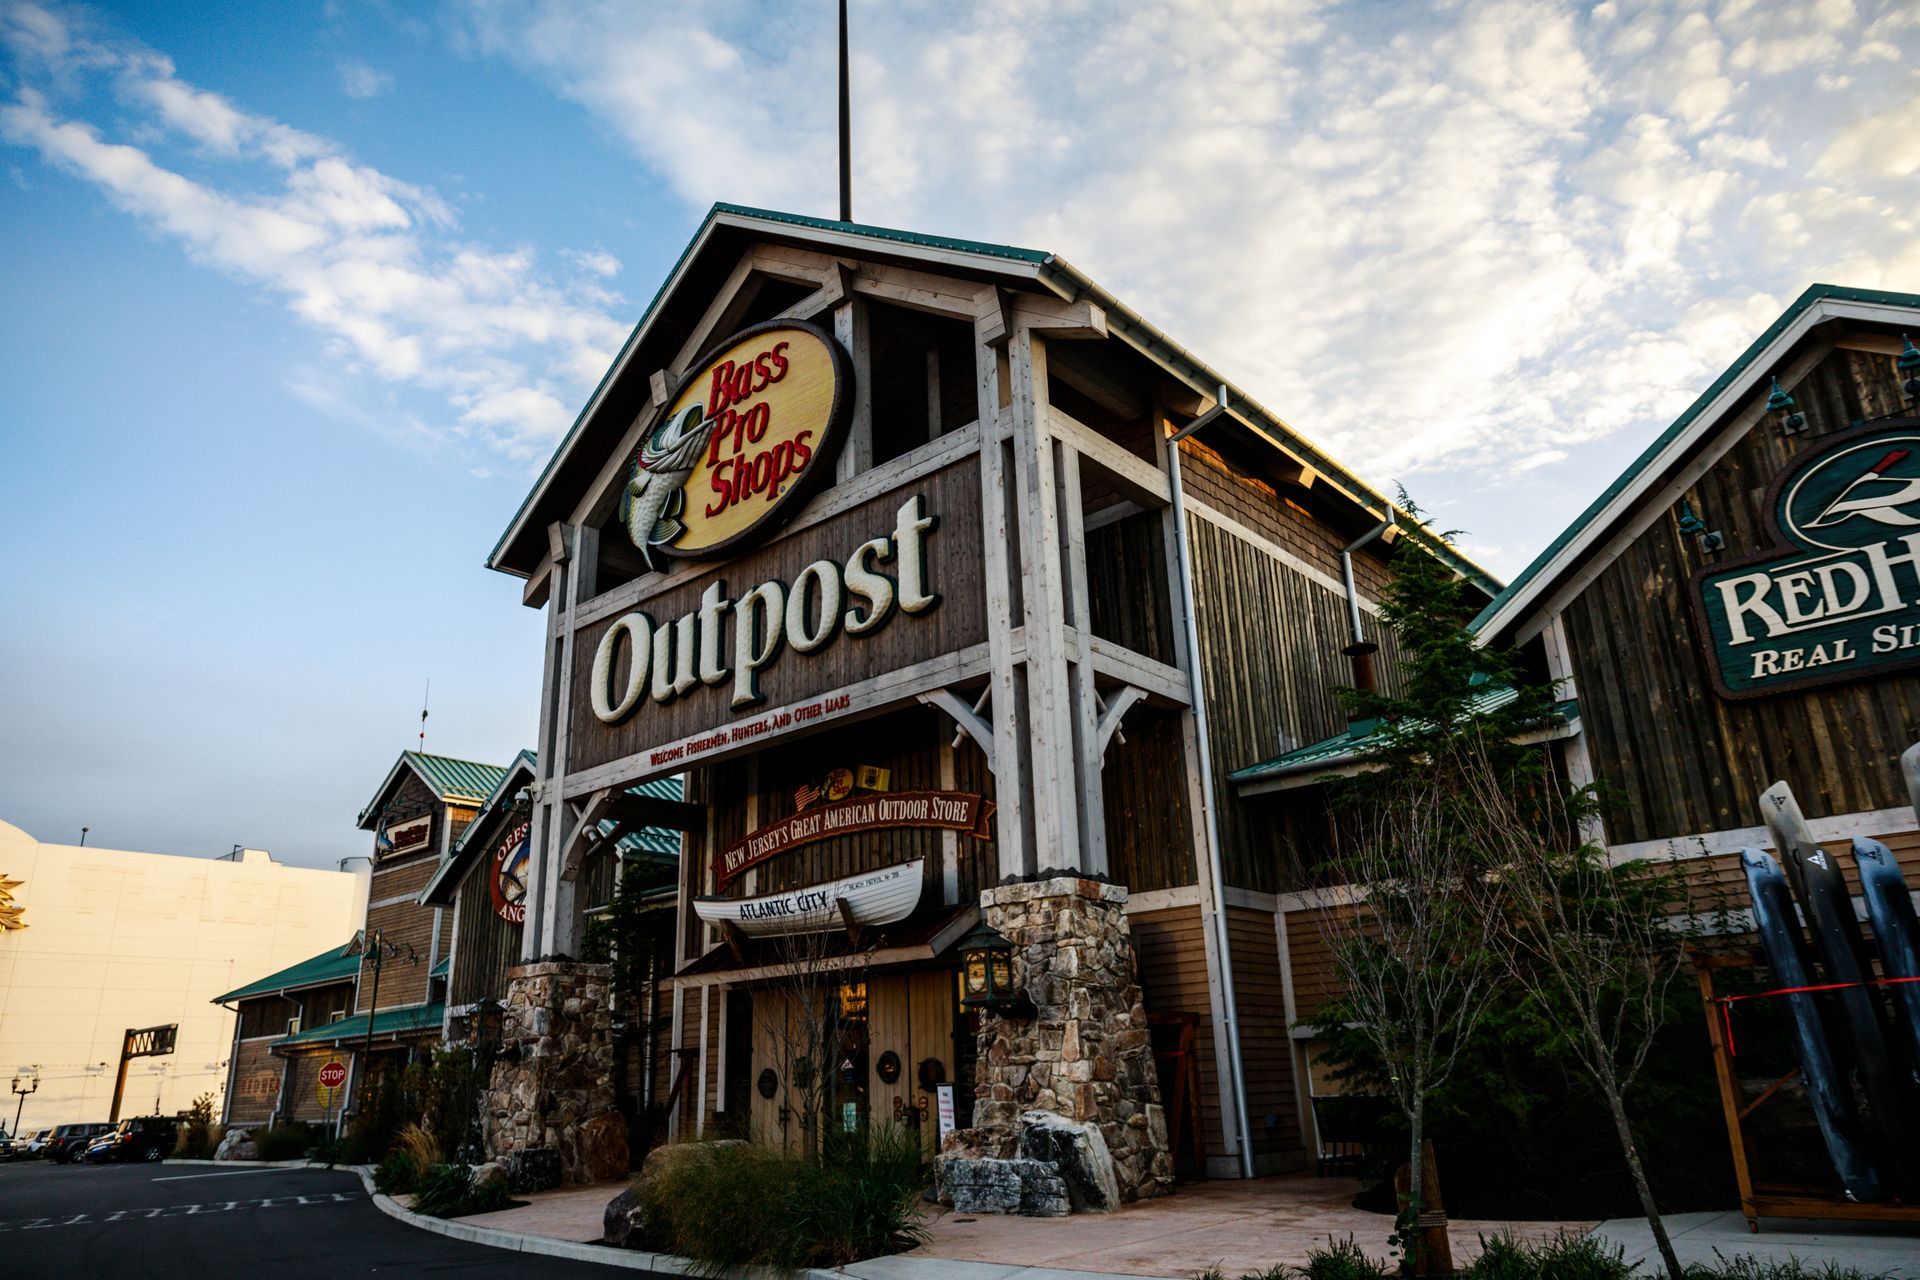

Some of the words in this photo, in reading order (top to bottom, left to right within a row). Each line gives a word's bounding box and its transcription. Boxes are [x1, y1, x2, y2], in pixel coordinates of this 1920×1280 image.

[706, 341, 789, 420] Bass
[706, 402, 770, 469] Pro
[706, 430, 813, 519] Shops
[591, 494, 938, 724] Outpost
[1750, 639, 1856, 679] REAL
[650, 746, 684, 767] WELCOME
[686, 732, 731, 756] FISHERMEN,
[731, 719, 771, 743] HUNTERS,
[772, 713, 792, 730] AND
[794, 703, 822, 723] OTHER
[825, 694, 850, 714] LIARS
[724, 847, 745, 873] NEW
[747, 827, 789, 860] JERSEY'S
[790, 814, 821, 840] GREAT
[824, 803, 875, 829] AMERICAN
[878, 798, 928, 821] OUTDOOR
[931, 797, 969, 823] STORE
[739, 897, 795, 921] ATLANTIC
[797, 891, 828, 912] CITY
[321, 1069, 345, 1081] STOP
